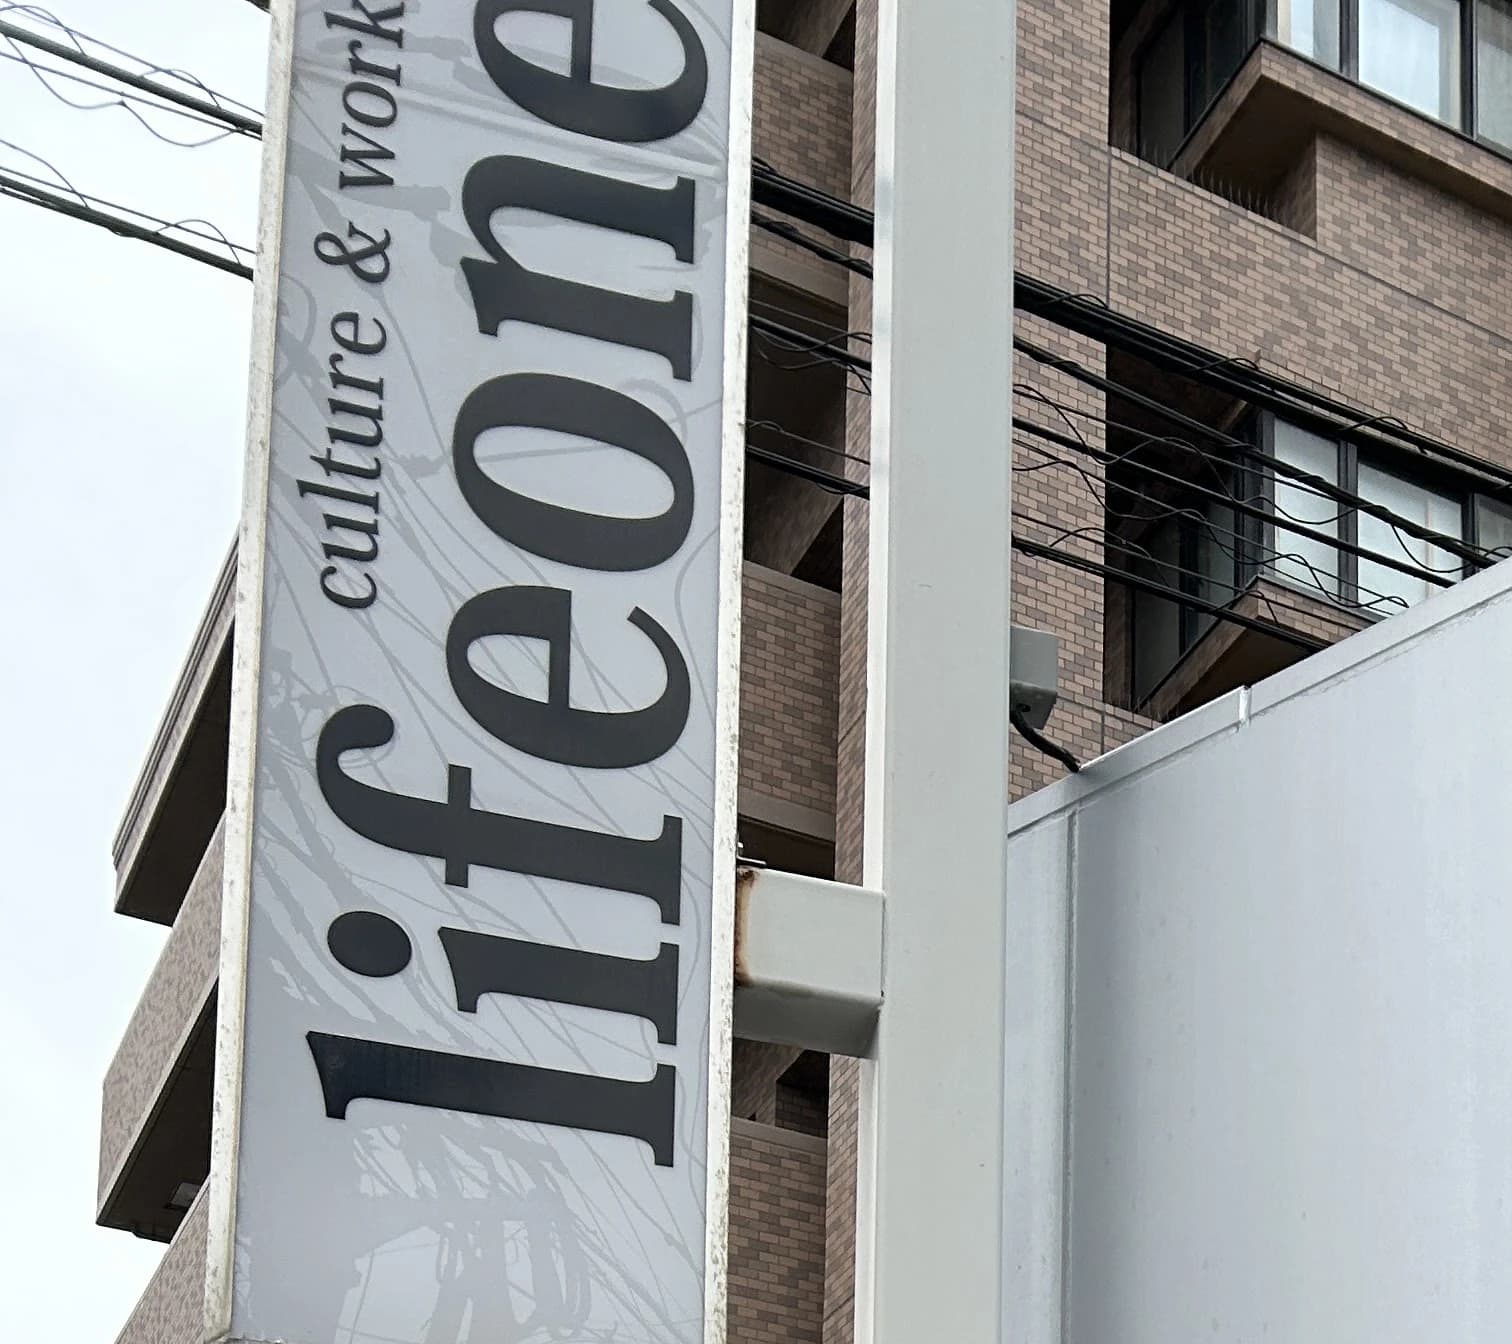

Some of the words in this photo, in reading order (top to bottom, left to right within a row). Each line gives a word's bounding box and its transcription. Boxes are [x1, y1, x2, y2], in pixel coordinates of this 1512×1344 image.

[323, 0, 405, 190] work
[314, 221, 392, 284] &
[296, 310, 388, 610] culture
[305, 0, 709, 1167] lifeone
